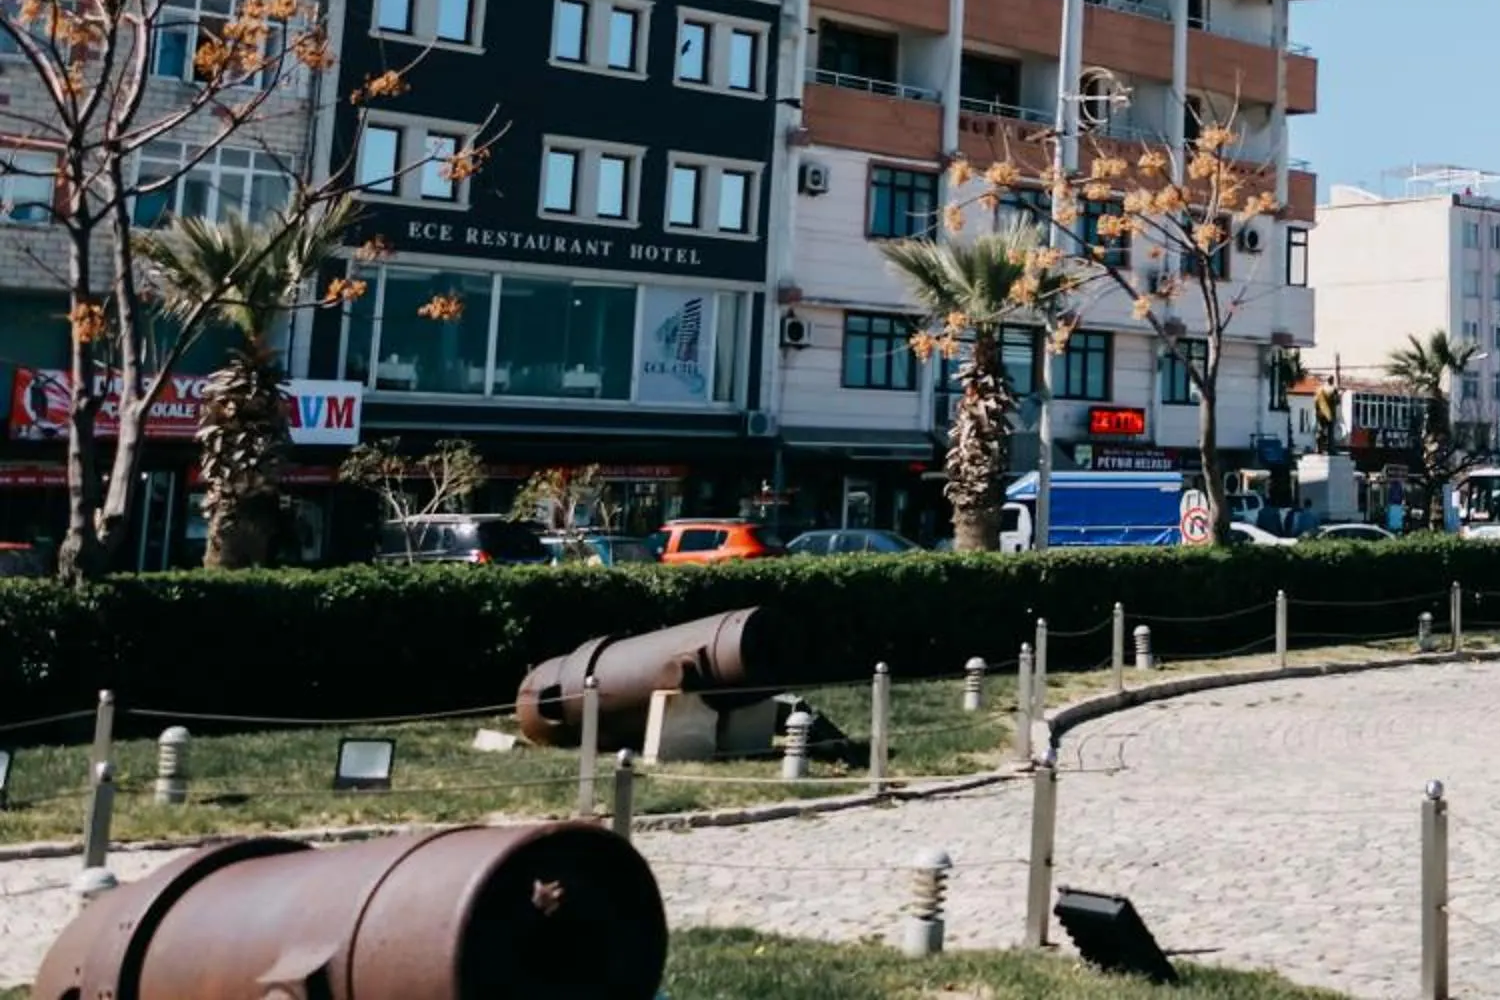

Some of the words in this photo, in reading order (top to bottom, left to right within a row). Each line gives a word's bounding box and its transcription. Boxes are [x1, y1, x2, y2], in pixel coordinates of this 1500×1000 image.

[408, 221, 453, 242] ECE
[465, 226, 614, 257] RESTAURANT
[629, 243, 702, 266] HOTEL
